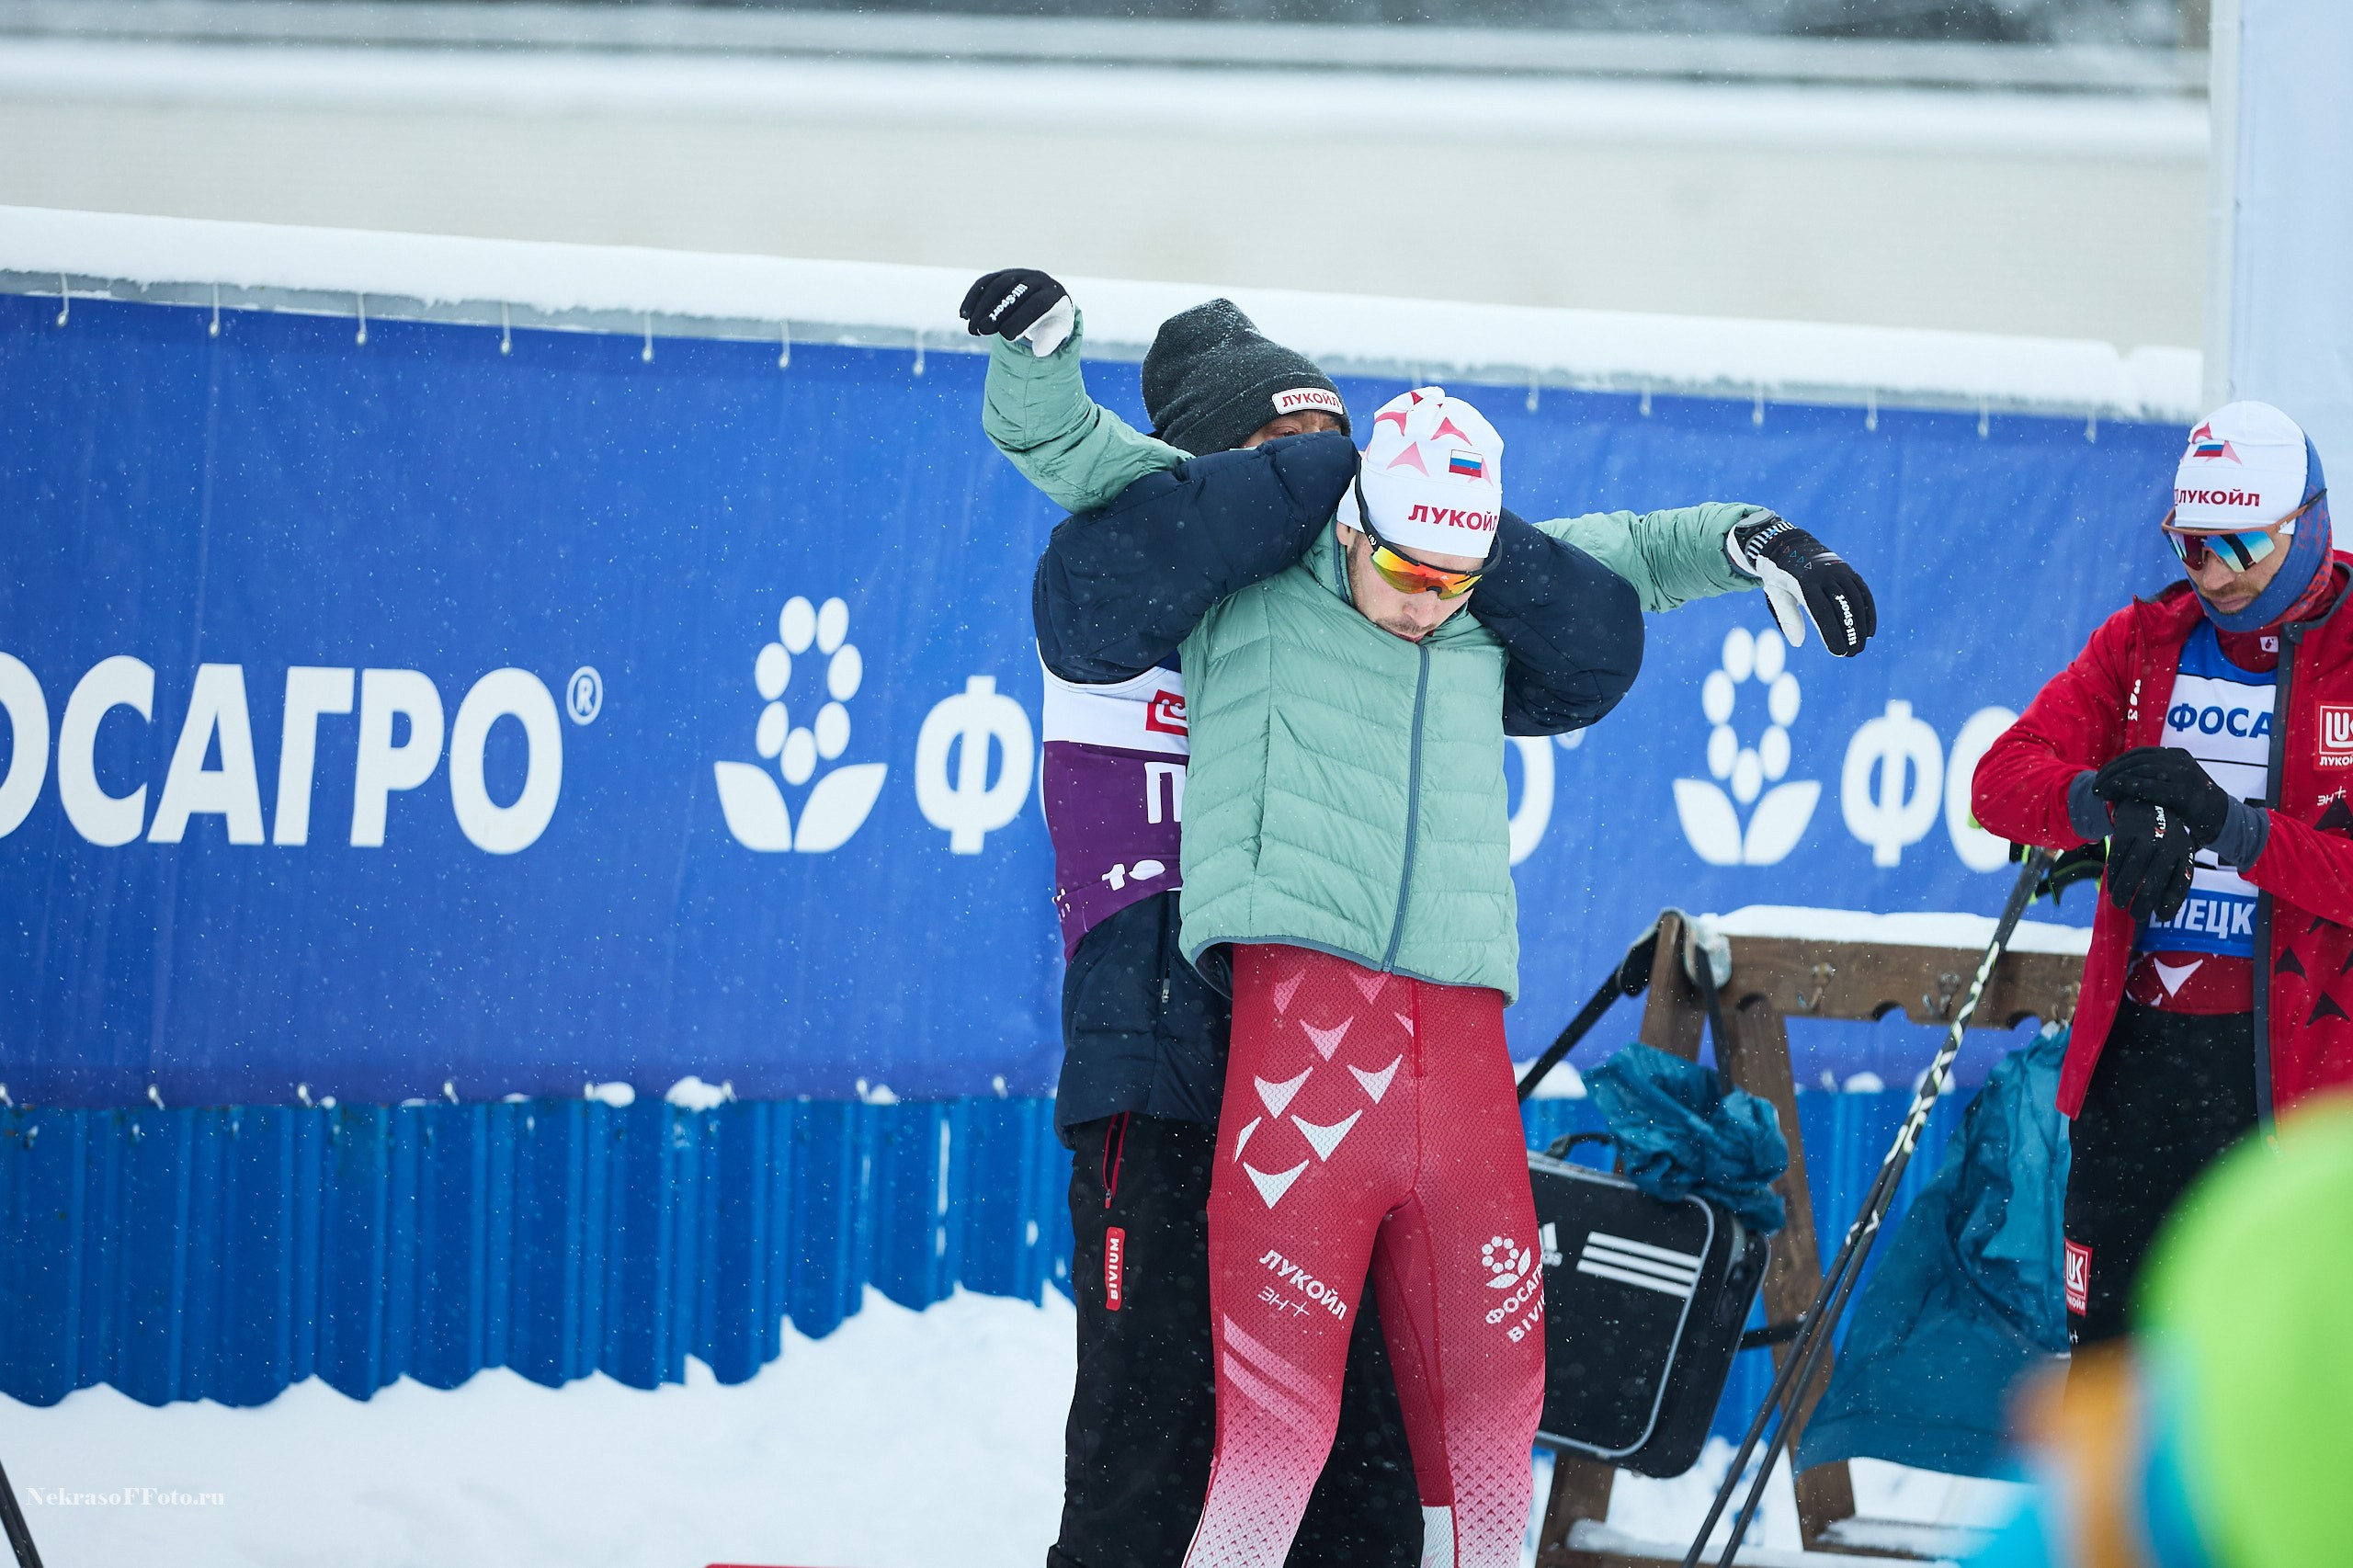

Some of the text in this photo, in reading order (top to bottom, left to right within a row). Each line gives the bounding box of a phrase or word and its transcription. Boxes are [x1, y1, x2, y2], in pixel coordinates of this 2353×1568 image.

[1281, 392, 1340, 407] ЛУКОЙЛ
[2178, 488, 2260, 507] ЛУКОЙЛ
[1408, 504, 1498, 532] ЛУКОЙЛ
[2319, 756, 2353, 767] ЛУКО
[1108, 1238, 1120, 1301] BIVIUM
[1258, 1249, 1347, 1321] ЛУКОЙЛ
[1485, 1252, 1544, 1324] ФОСАГР
